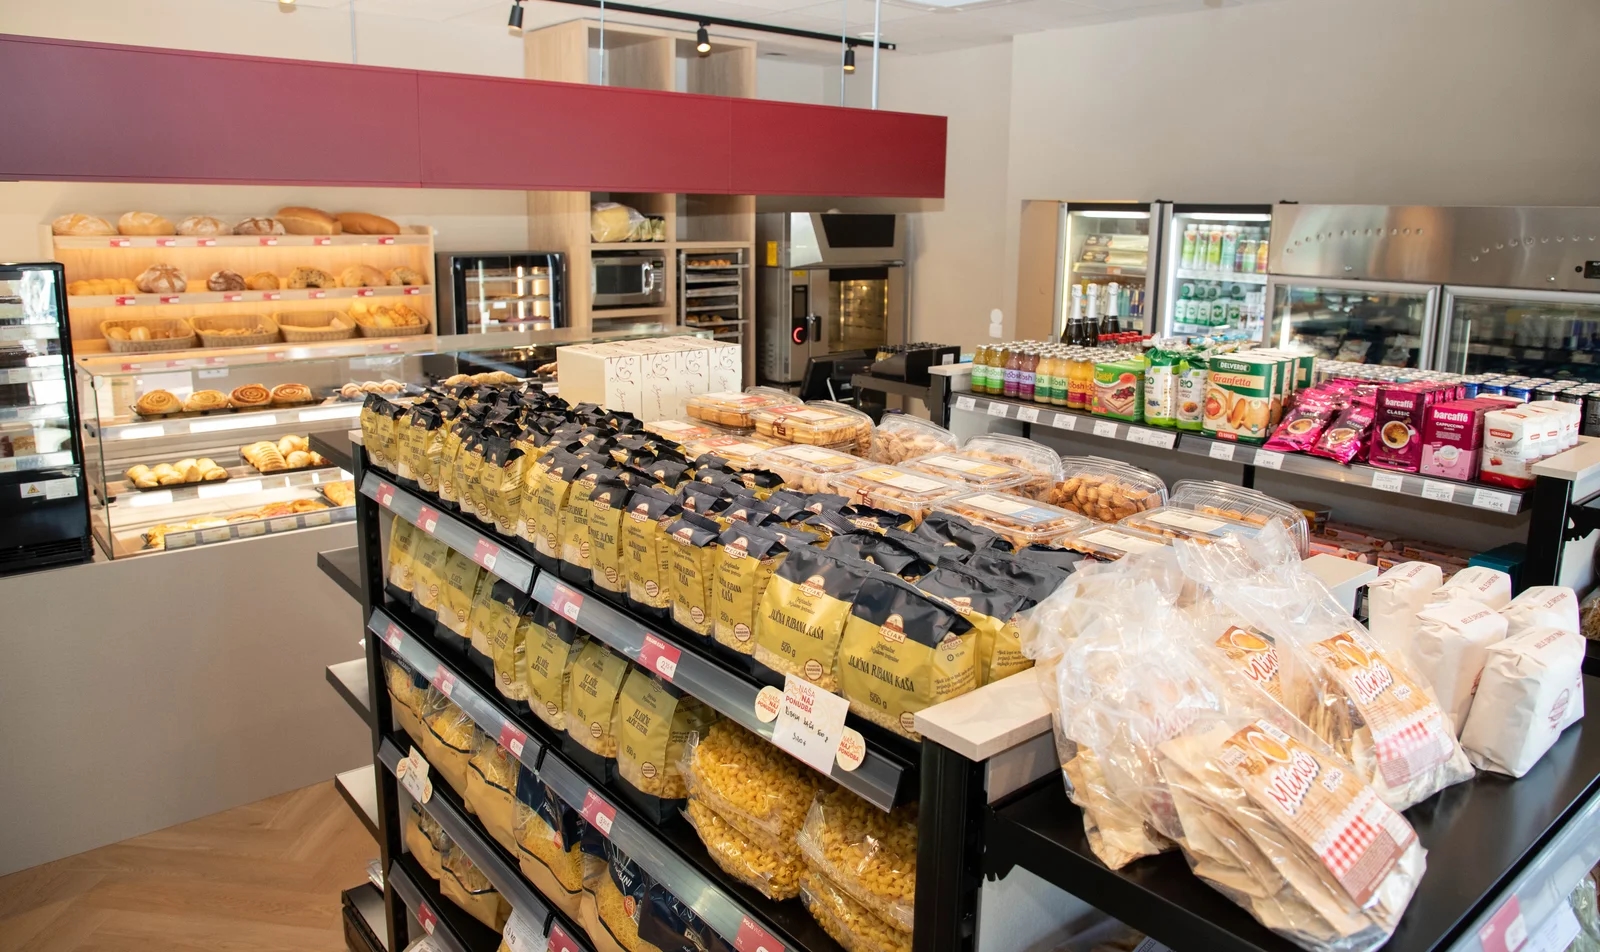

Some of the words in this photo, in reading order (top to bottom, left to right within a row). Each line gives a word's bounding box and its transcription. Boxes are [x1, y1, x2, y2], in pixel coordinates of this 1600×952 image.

[1220, 362, 1248, 371] DELVERDE
[1213, 373, 1251, 387] Granfetta
[1385, 398, 1413, 408] barcaffé
[1387, 409, 1410, 417] CLASSIC
[1433, 410, 1468, 422] barcaffé
[1436, 421, 1464, 429] CAPPUCCINO
[725, 546, 747, 558] PEČIAK
[721, 590, 734, 603] KAŠA
[799, 585, 823, 598] PEČIAK
[786, 617, 807, 634] RIBANA
[806, 625, 824, 640] KAŠA
[880, 626, 904, 642] PEČIAK
[781, 641, 792, 654] 500
[791, 649, 796, 657] g
[848, 655, 870, 673] JAJČNA
[871, 664, 894, 685] RIBANA
[895, 676, 915, 692] KAŠA
[799, 685, 815, 698] NAŠA
[870, 691, 881, 704] 500
[769, 701, 779, 710] NAJ
[785, 695, 812, 714] PONUDBA
[801, 695, 814, 706] NAJ
[757, 700, 777, 715] PONUDBA
[840, 741, 850, 750] NAJ
[842, 735, 855, 745] NAŠA
[838, 747, 859, 762] PONUDBA
[1268, 749, 1318, 811] Mlinci
